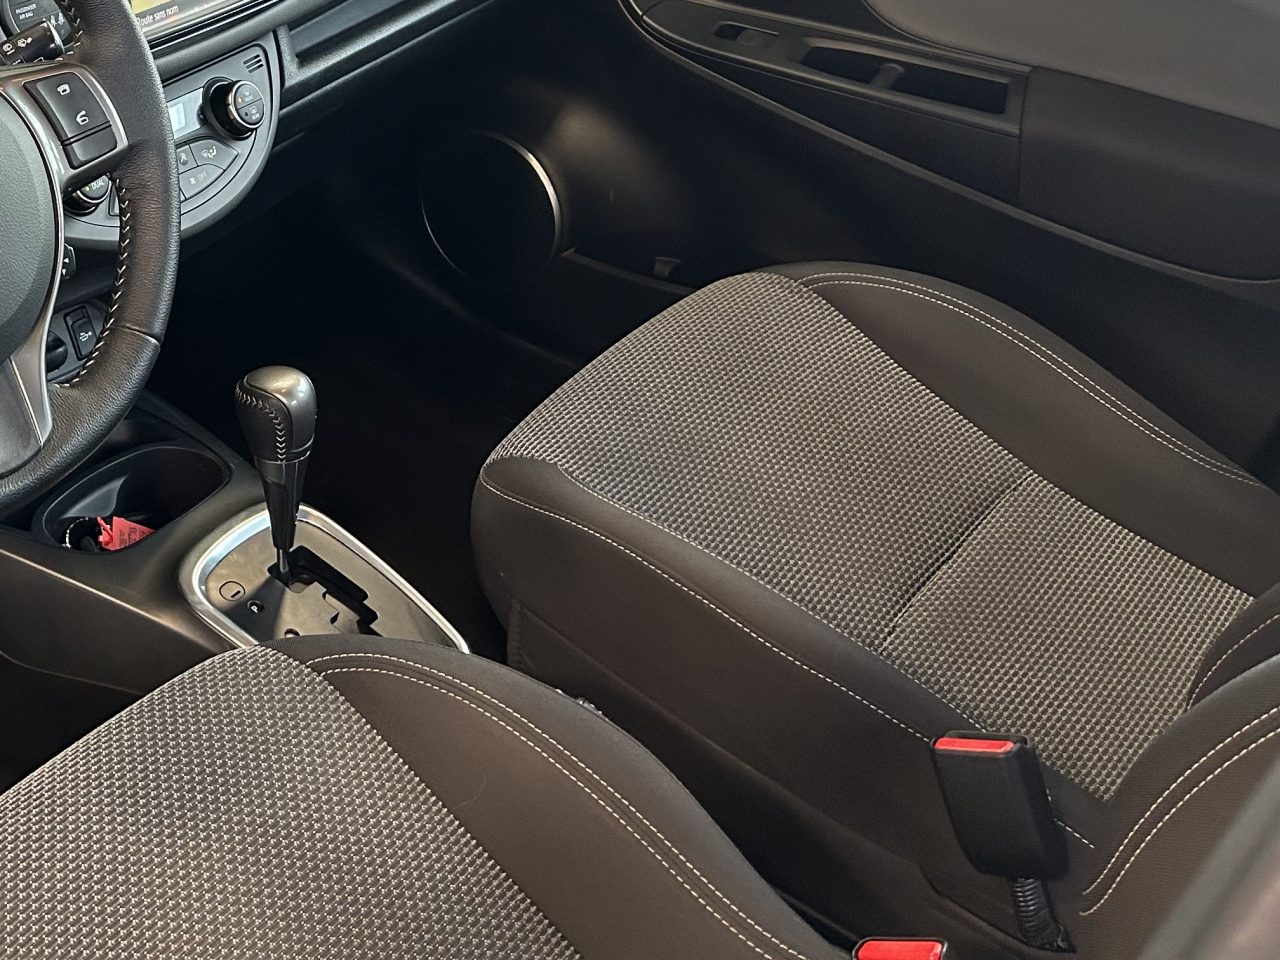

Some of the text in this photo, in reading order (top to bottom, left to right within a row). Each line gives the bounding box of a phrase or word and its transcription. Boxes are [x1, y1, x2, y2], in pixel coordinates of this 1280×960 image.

[166, 5, 179, 18] nom
[91, 178, 106, 190] DUAL
[250, 605, 259, 614] P
